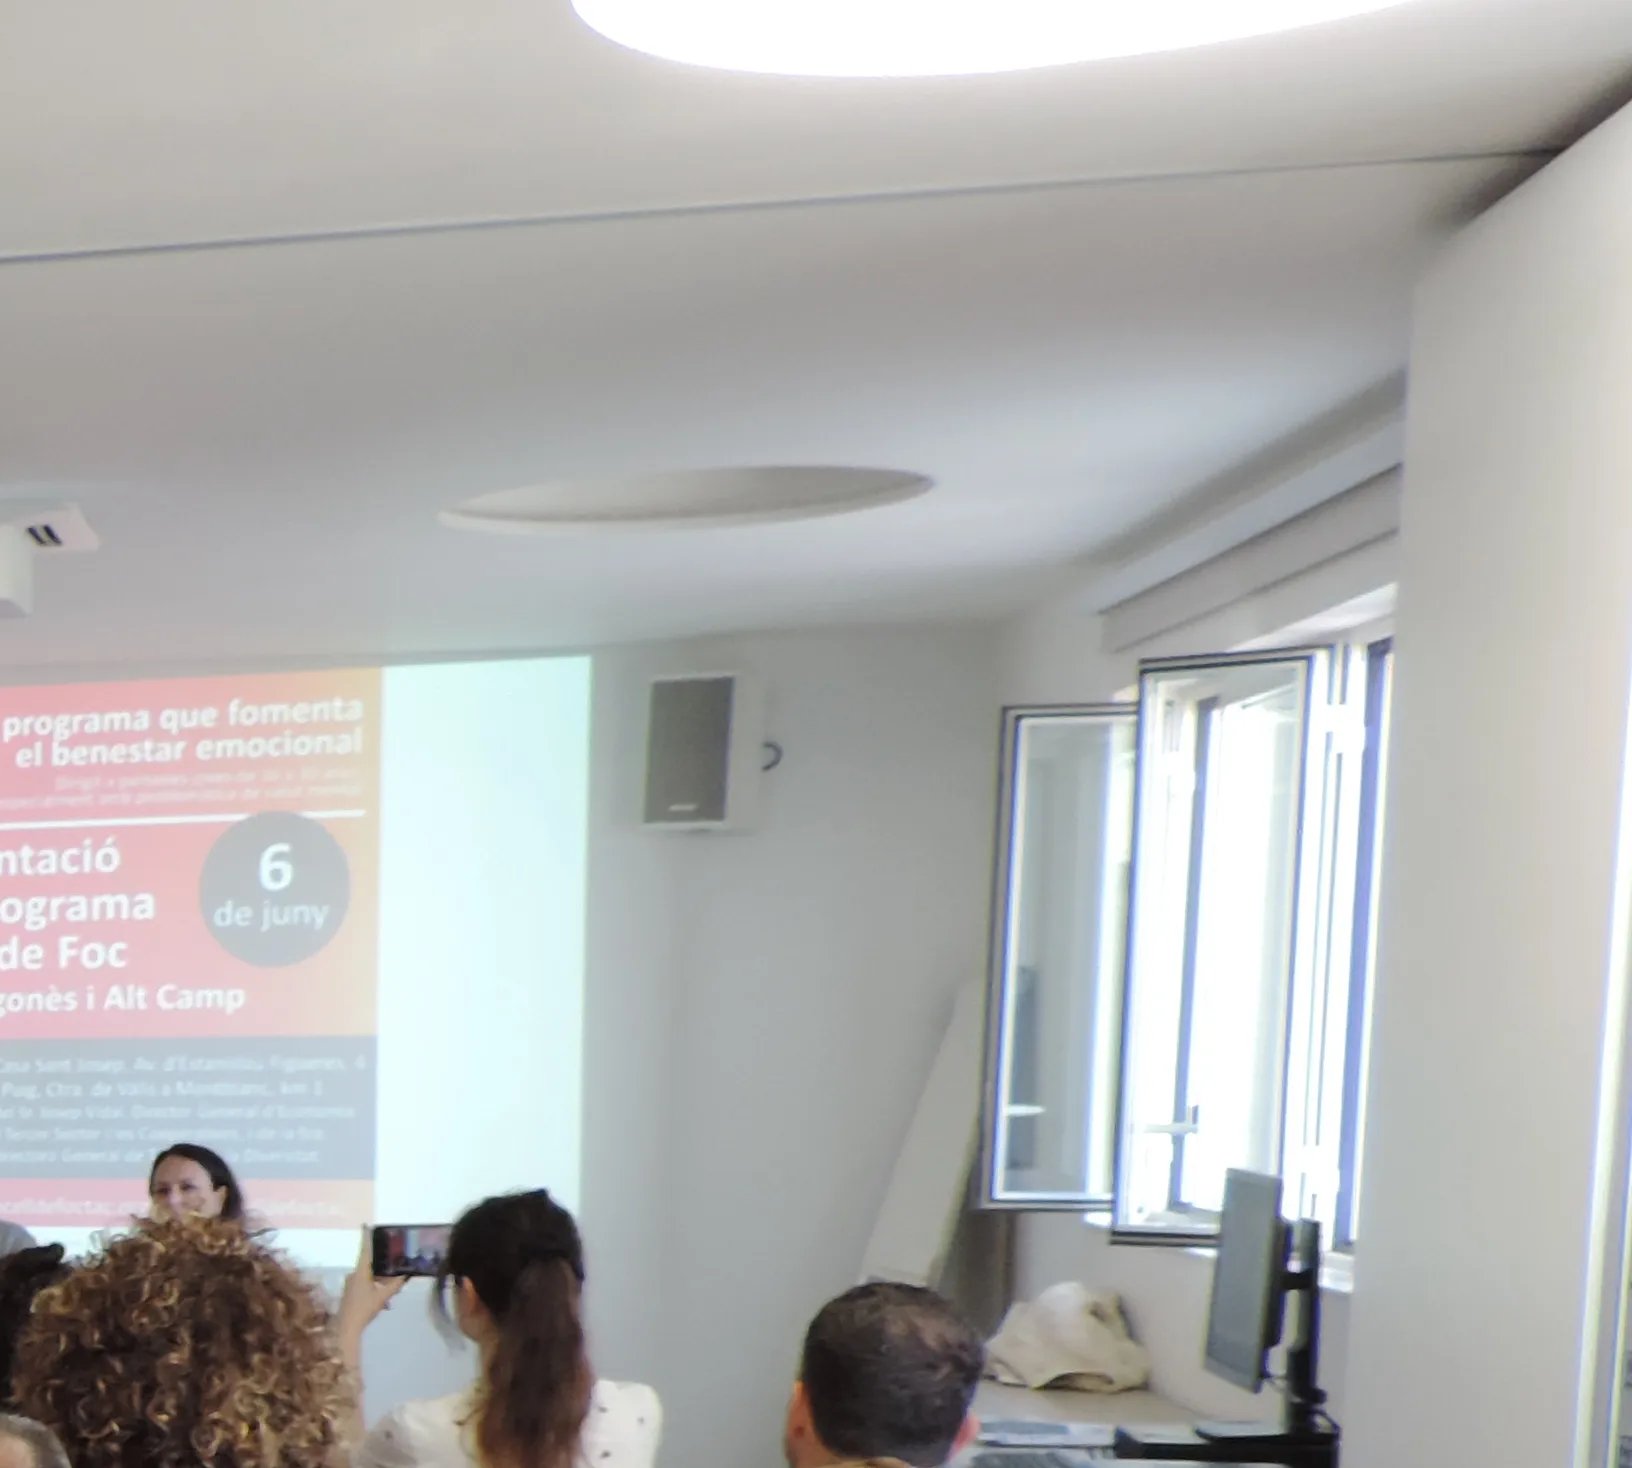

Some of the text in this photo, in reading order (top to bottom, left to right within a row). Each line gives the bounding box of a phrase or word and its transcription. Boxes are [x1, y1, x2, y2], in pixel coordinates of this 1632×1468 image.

[2, 707, 150, 742] programa
[158, 704, 220, 736] que
[227, 697, 364, 727] fomenta
[15, 725, 364, 769] el benestar emocional
[257, 842, 295, 892] 6
[212, 899, 330, 931] de juny
[58, 935, 129, 970] Foc
[84, 984, 95, 1011] i
[103, 982, 148, 1011] Alt
[155, 982, 247, 1015] Camp
